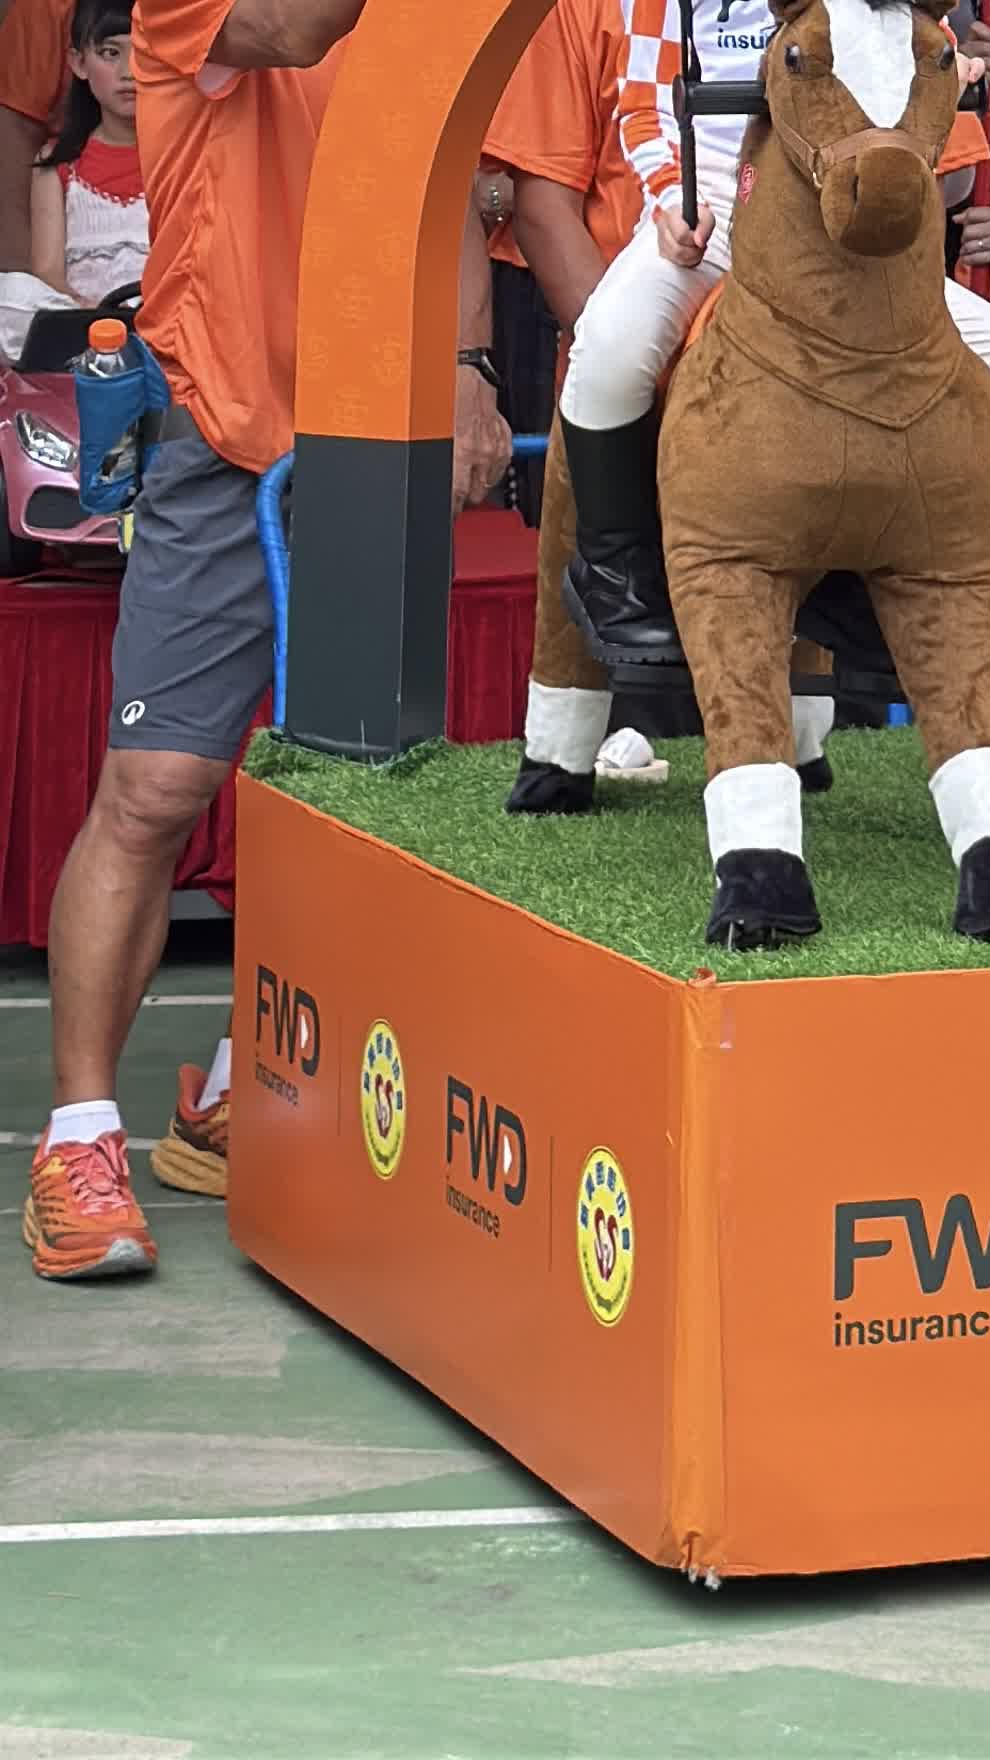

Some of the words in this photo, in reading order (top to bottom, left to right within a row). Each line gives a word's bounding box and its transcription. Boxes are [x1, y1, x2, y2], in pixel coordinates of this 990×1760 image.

[717, 28, 773, 51] insu
[257, 963, 321, 1077] FWD
[447, 1074, 527, 1206] FWD
[446, 1174, 500, 1239] insurance
